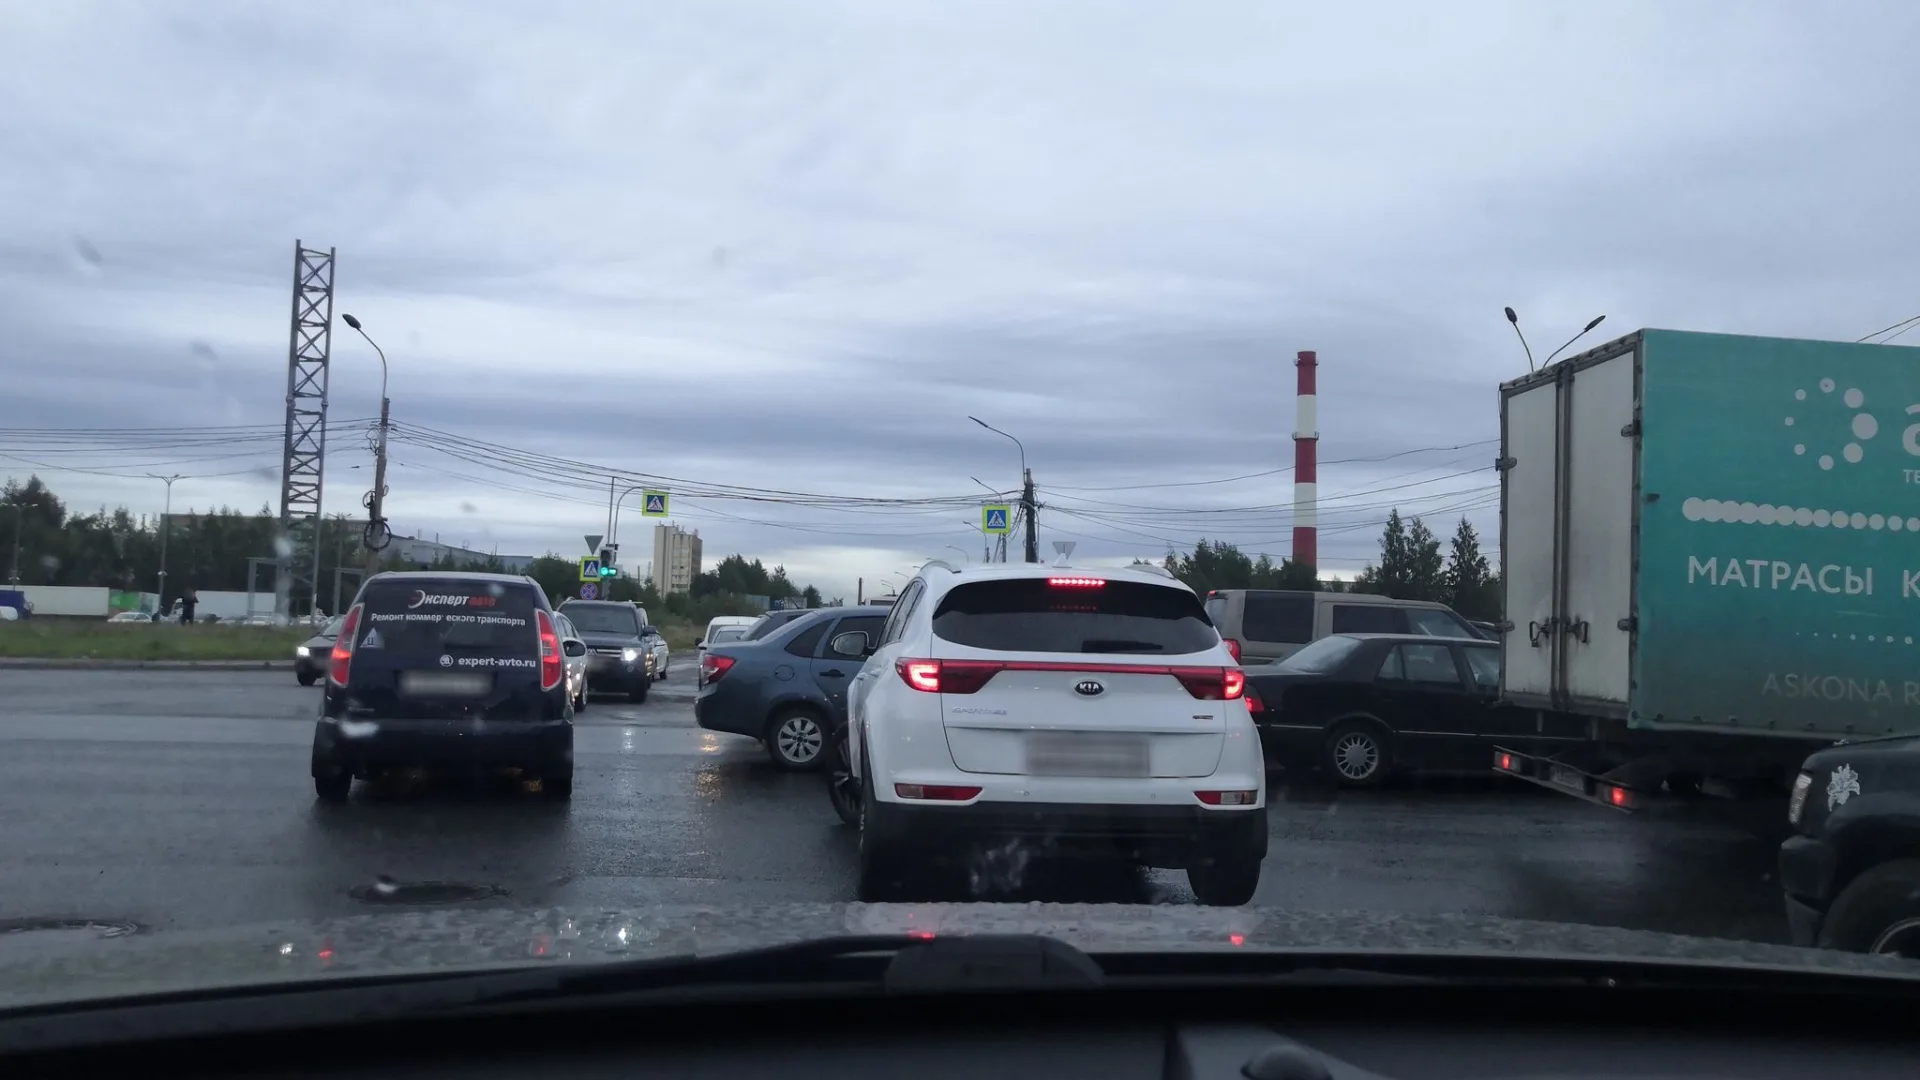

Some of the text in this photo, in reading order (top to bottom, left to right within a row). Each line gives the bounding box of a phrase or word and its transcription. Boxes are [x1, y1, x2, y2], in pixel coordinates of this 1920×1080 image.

[1688, 555, 1873, 595] МАТРАСЫ
[371, 613, 526, 626] Ремонт коммереского транспорта
[458, 658, 536, 668] expert-avto.ru
[1079, 683, 1099, 692] KIA
[1761, 672, 1892, 706] ASKONA
